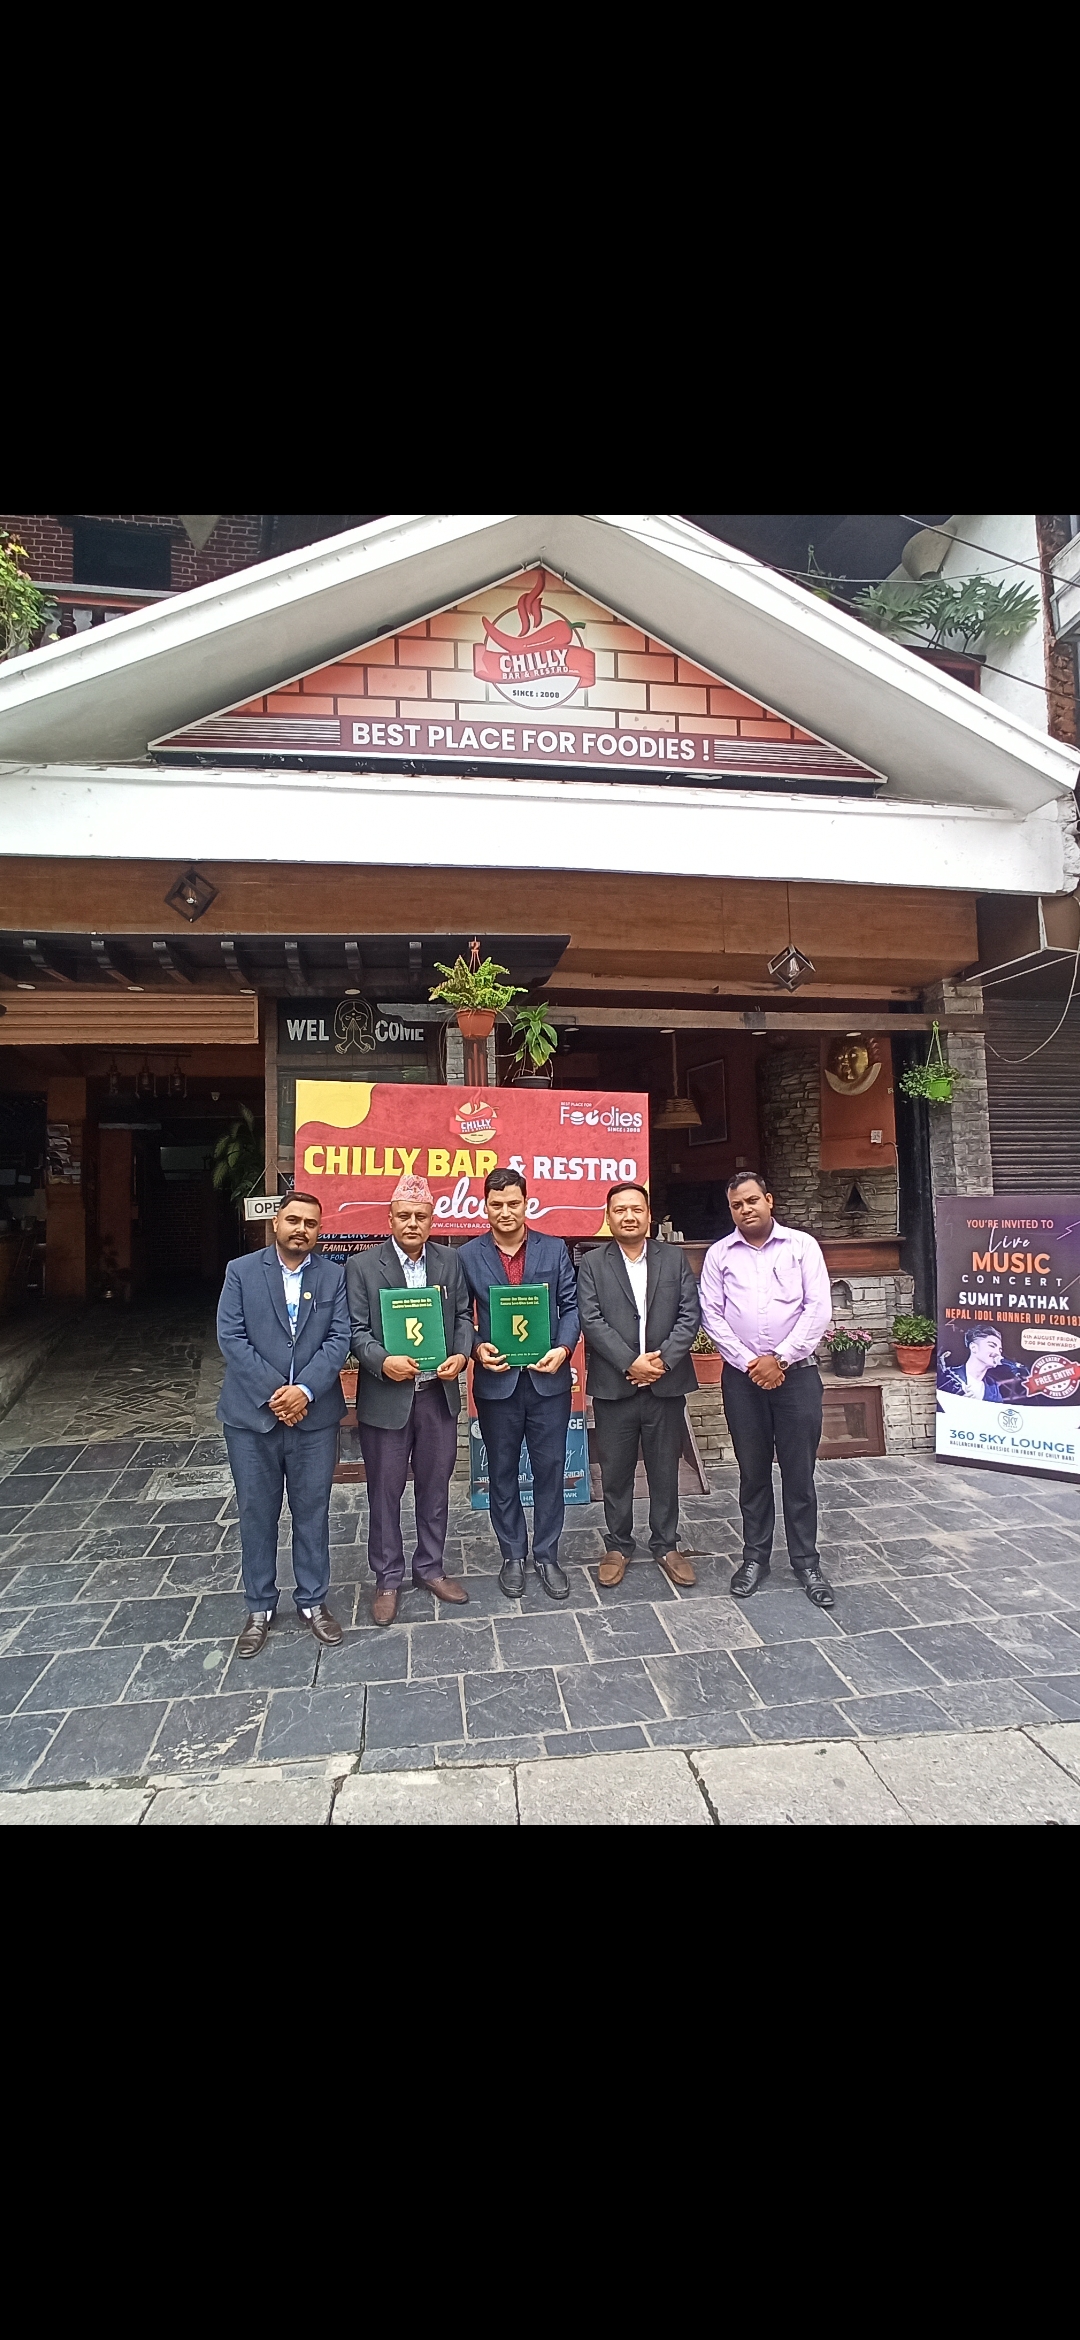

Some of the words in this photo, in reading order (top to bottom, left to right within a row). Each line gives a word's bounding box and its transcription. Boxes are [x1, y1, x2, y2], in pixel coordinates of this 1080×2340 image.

[499, 648, 569, 673] CHILLY
[502, 671, 520, 680] BAR
[524, 670, 530, 678] &
[533, 666, 569, 677] RESTRO
[512, 689, 534, 698] SINCE
[540, 691, 560, 699] 2008
[352, 722, 421, 747] BEST
[427, 725, 516, 751] PLACE
[522, 729, 576, 754] FOR
[582, 732, 695, 761] FOODIES
[286, 1019, 330, 1041] WEL
[374, 1020, 424, 1042] COME
[461, 1118, 491, 1130] CHILLY
[303, 1145, 420, 1176] CHILLY
[427, 1148, 498, 1178] BAR
[533, 1155, 637, 1182] RESTRO
[254, 1202, 281, 1214] OPE
[966, 1219, 999, 1229] YOU'RE
[1001, 1219, 1038, 1229] INVITED
[1041, 1219, 1054, 1229] TO
[322, 1243, 353, 1252] FAMILY
[972, 1251, 1051, 1274] MUSIC
[961, 1274, 1062, 1287] CONCERT
[958, 1291, 1003, 1307] SUMIT
[1008, 1294, 1070, 1311] PATHAK
[945, 1308, 971, 1320] NEPAL
[974, 1310, 994, 1321] IDOL
[996, 1311, 1031, 1324] RUNNER
[1034, 1313, 1046, 1325] UP
[1034, 1374, 1054, 1386] FREE
[1052, 1367, 1076, 1381] ENTRY
[949, 1429, 975, 1441] 360
[979, 1433, 1006, 1445] SKY
[1011, 1437, 1075, 1454] LOUNGE
